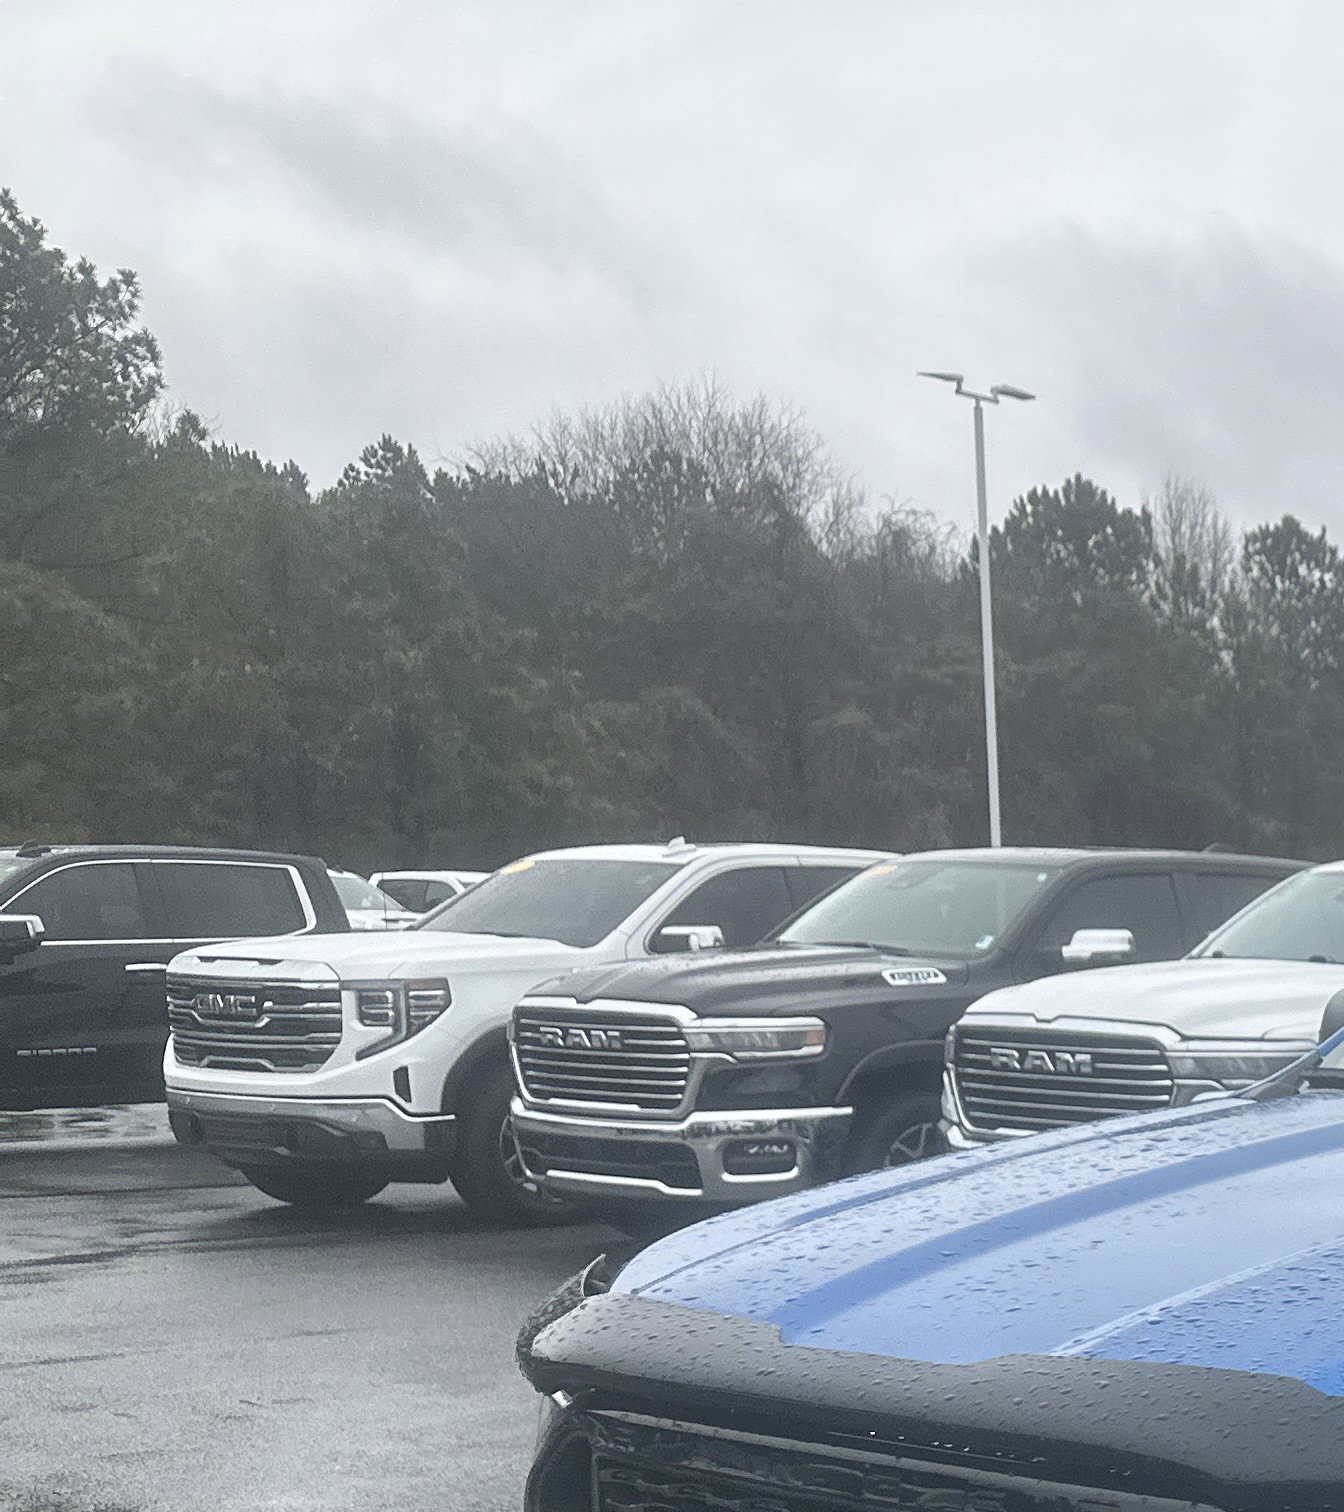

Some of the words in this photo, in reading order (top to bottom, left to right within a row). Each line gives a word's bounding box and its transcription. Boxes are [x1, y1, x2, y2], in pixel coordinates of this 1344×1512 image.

[196, 993, 257, 1014] GMC
[540, 1026, 621, 1049] RAM
[16, 1047, 97, 1056] SIERRA
[990, 1047, 1093, 1073] RAM
